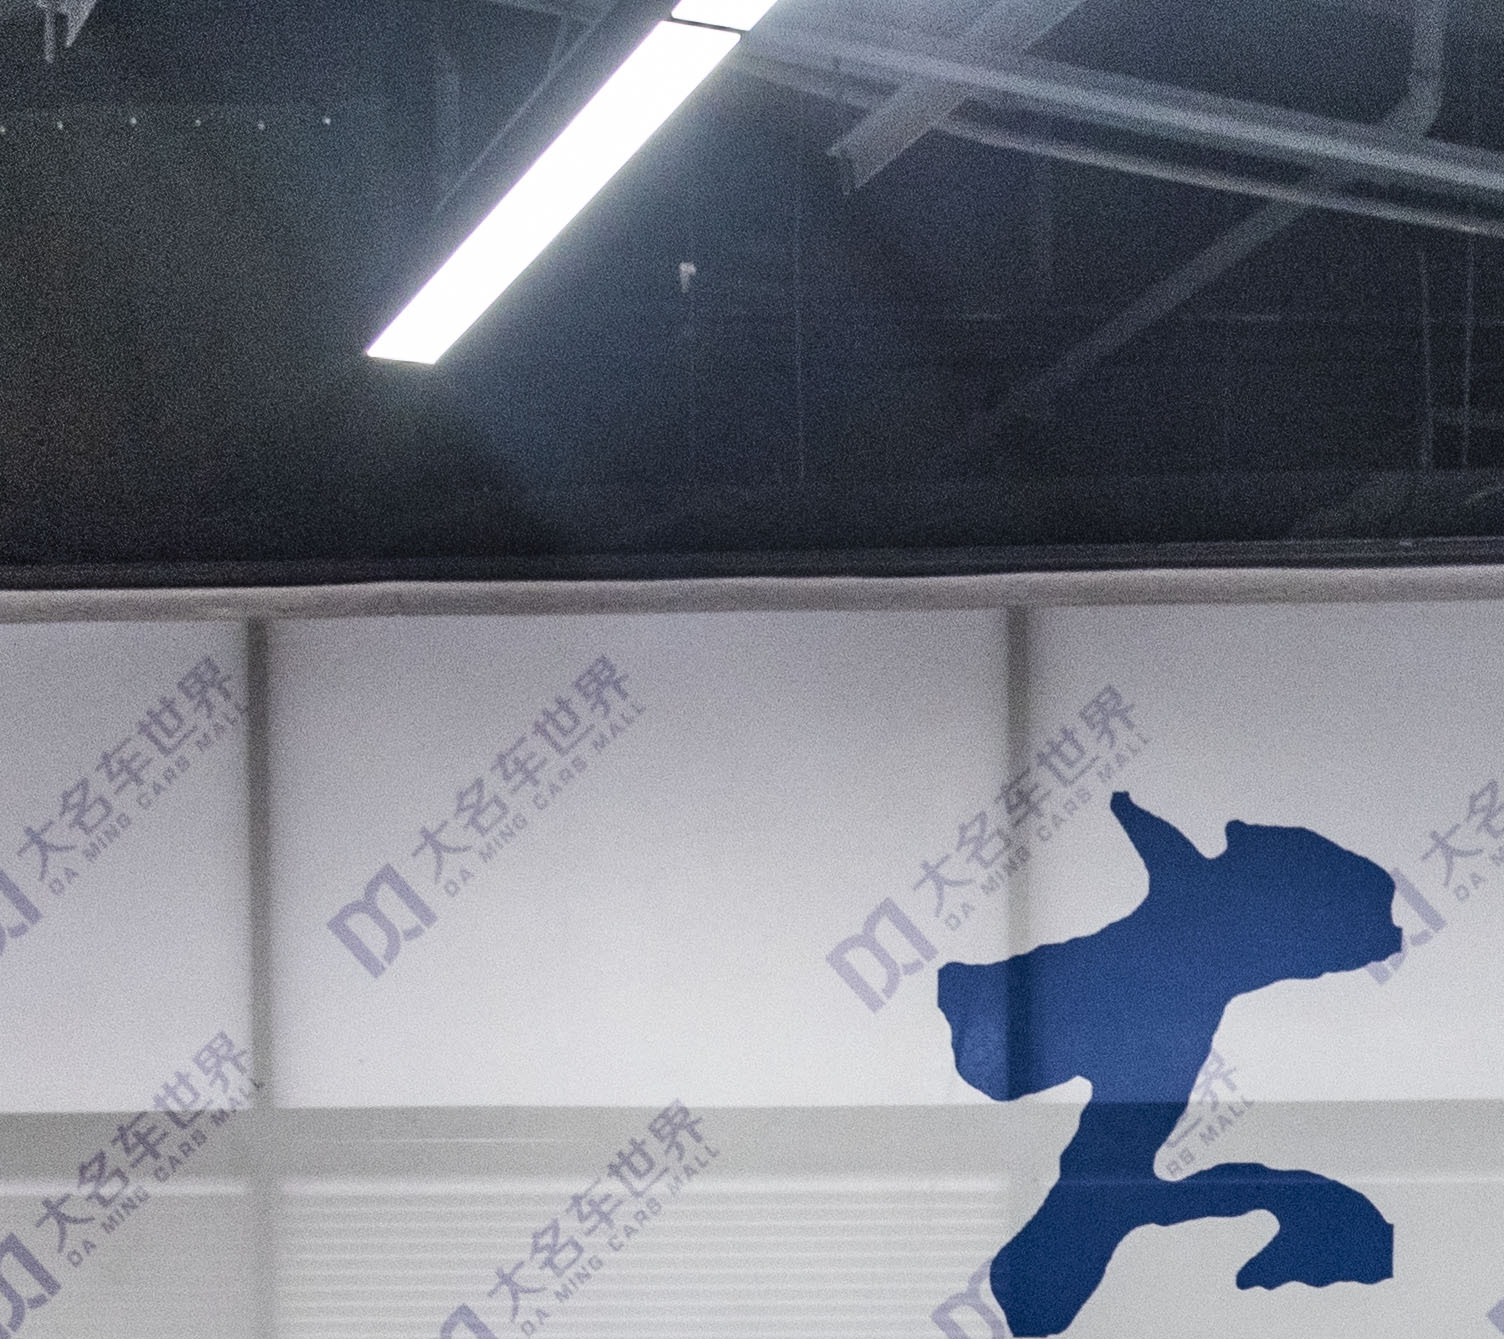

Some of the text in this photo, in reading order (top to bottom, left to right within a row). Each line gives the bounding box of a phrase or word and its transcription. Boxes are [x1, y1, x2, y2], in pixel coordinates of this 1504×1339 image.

[17, 657, 233, 883] 大名车世界
[411, 656, 630, 884] 大名车世界
[912, 684, 1135, 918] 大名车世界
[35, 1031, 248, 1254] 大名车世界
[487, 1097, 704, 1324] 大名车世界
